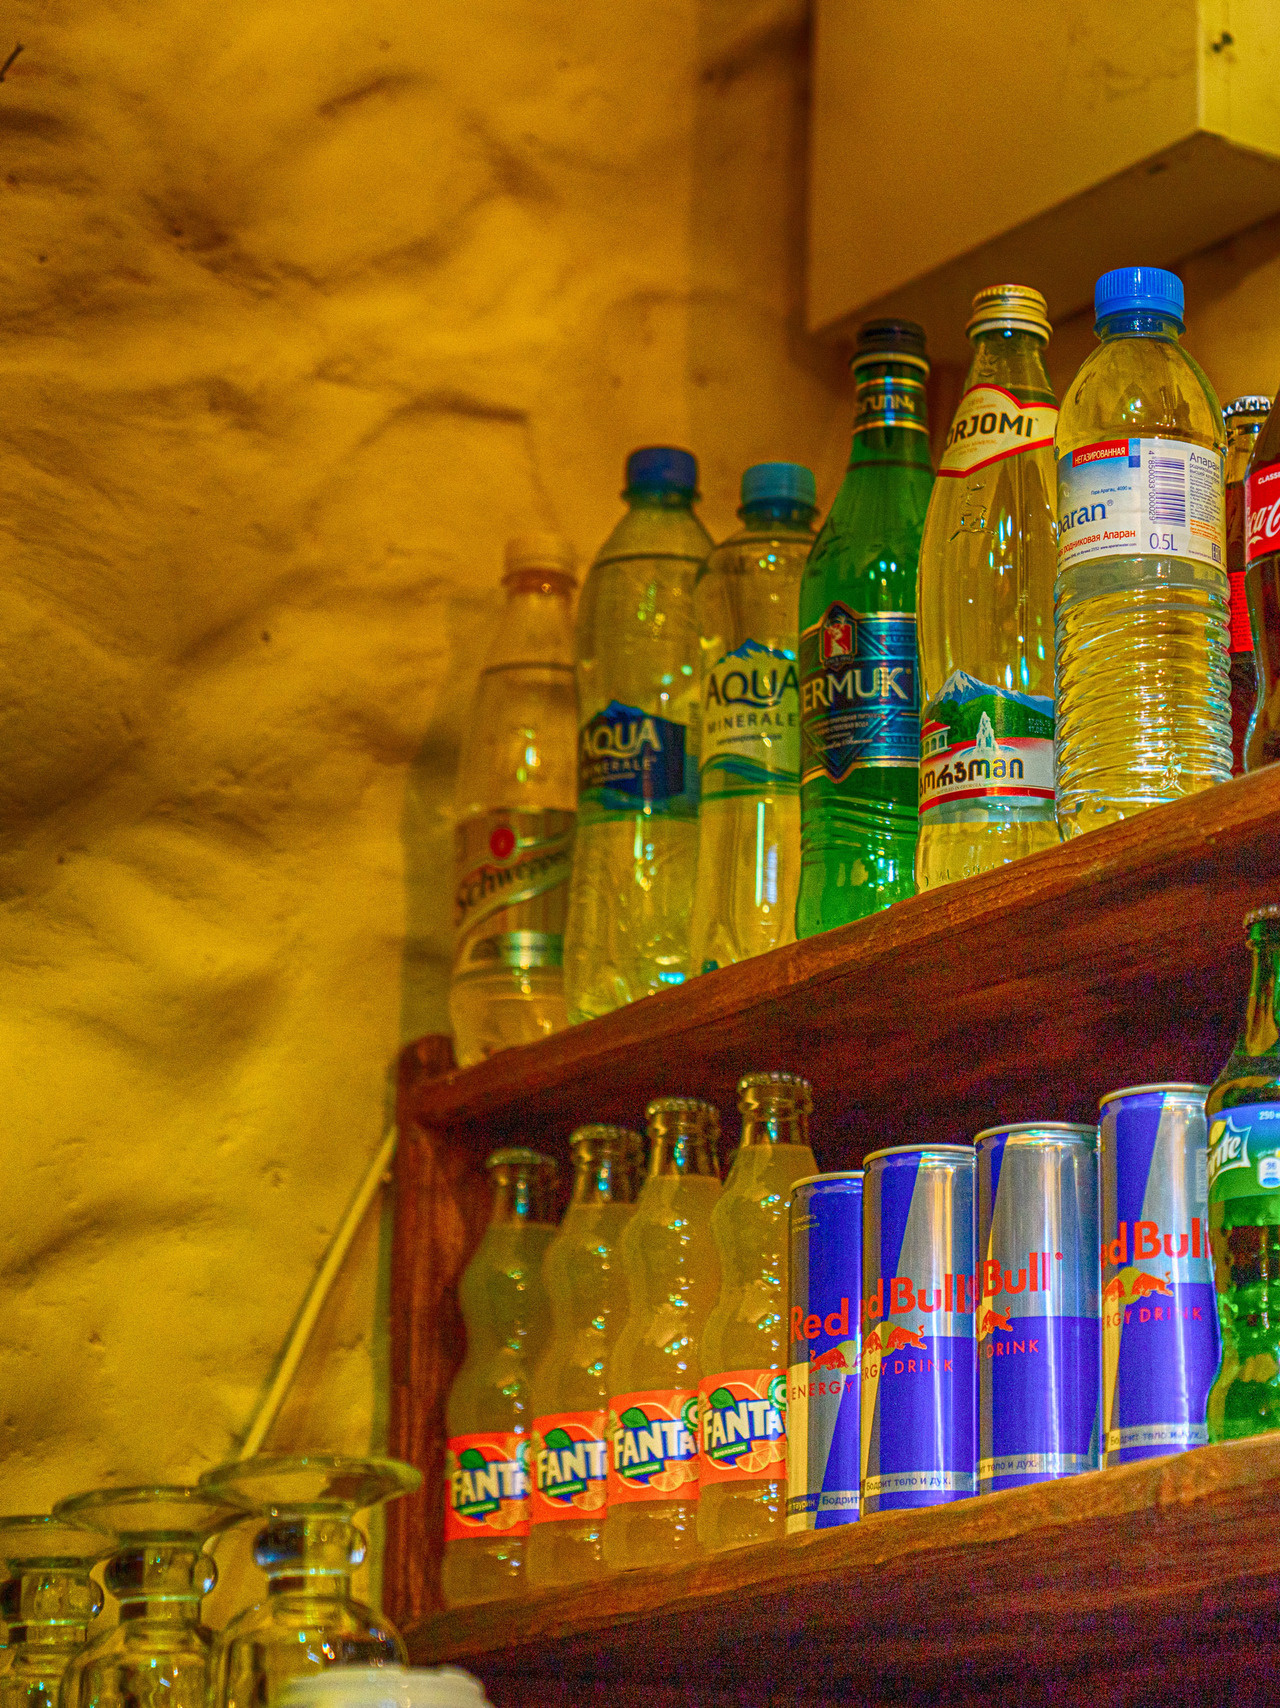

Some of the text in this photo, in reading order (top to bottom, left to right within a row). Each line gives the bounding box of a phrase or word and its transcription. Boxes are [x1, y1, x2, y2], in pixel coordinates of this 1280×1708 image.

[1074, 447, 1126, 465] НЕГАЗИРОВАННАЯ
[1064, 534, 1100, 556] родниковая
[1103, 530, 1136, 541] Апаран
[1149, 532, 1178, 551] 0.5L
[706, 665, 800, 710] AQUA
[801, 667, 909, 714] ERMUK
[708, 712, 797, 733] MINERALE
[1134, 1217, 1209, 1260] Bull
[983, 1252, 1051, 1298] Bull
[889, 1273, 966, 1315] Bull
[790, 1297, 849, 1343] Red
[986, 1339, 1039, 1359] DRINK
[894, 1359, 954, 1375] DRINK
[791, 1380, 854, 1401] ENERGY
[702, 1399, 785, 1452] FANTA
[613, 1420, 697, 1471] FANTA
[538, 1440, 608, 1490] FANT
[1017, 1459, 1037, 1471] дух.
[451, 1461, 532, 1508] FANTA
[866, 1476, 951, 1491] Бодрит тело и дух.
[822, 1495, 860, 1507] Бодрит
